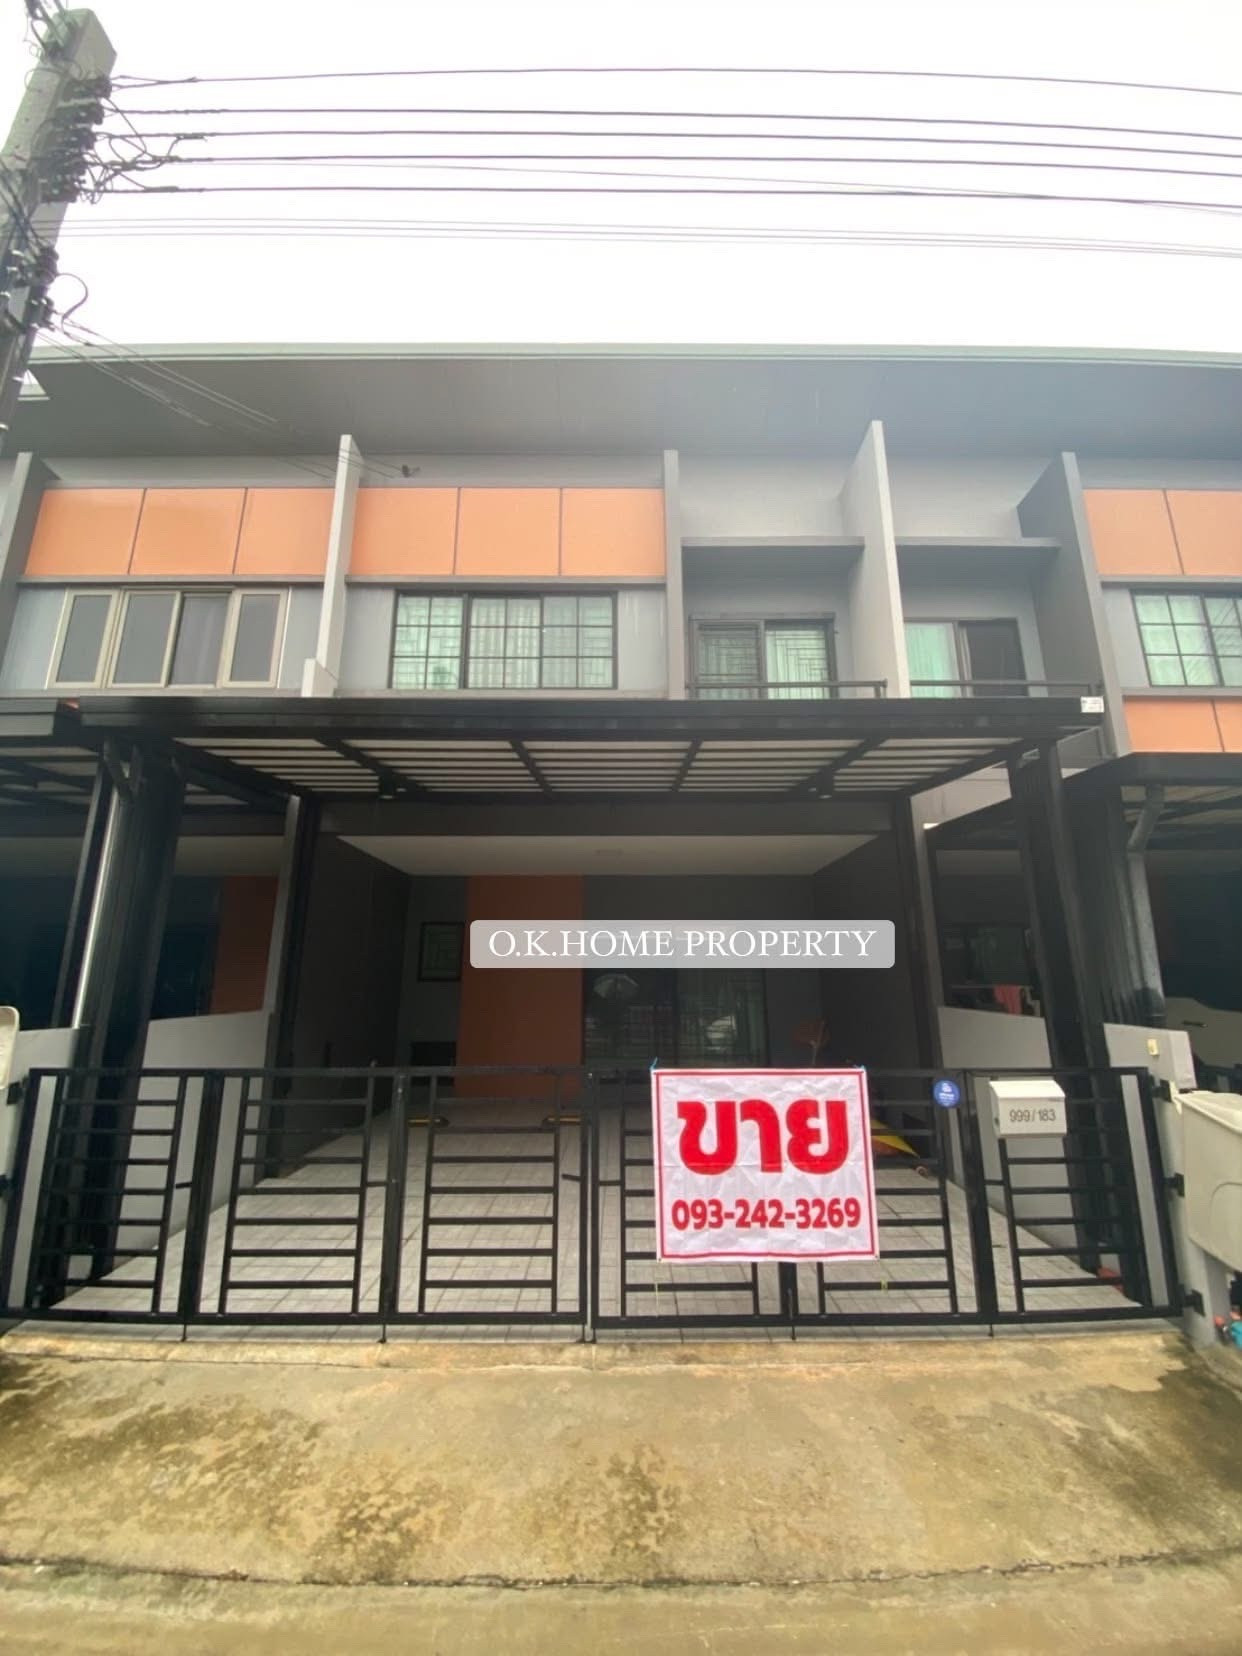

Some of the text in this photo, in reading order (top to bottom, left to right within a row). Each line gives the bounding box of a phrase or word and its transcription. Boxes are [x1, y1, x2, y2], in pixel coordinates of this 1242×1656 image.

[1009, 1108, 1056, 1122] 999/183
[677, 1099, 850, 1176] ขาย
[671, 1197, 861, 1231] 093-242-3269
